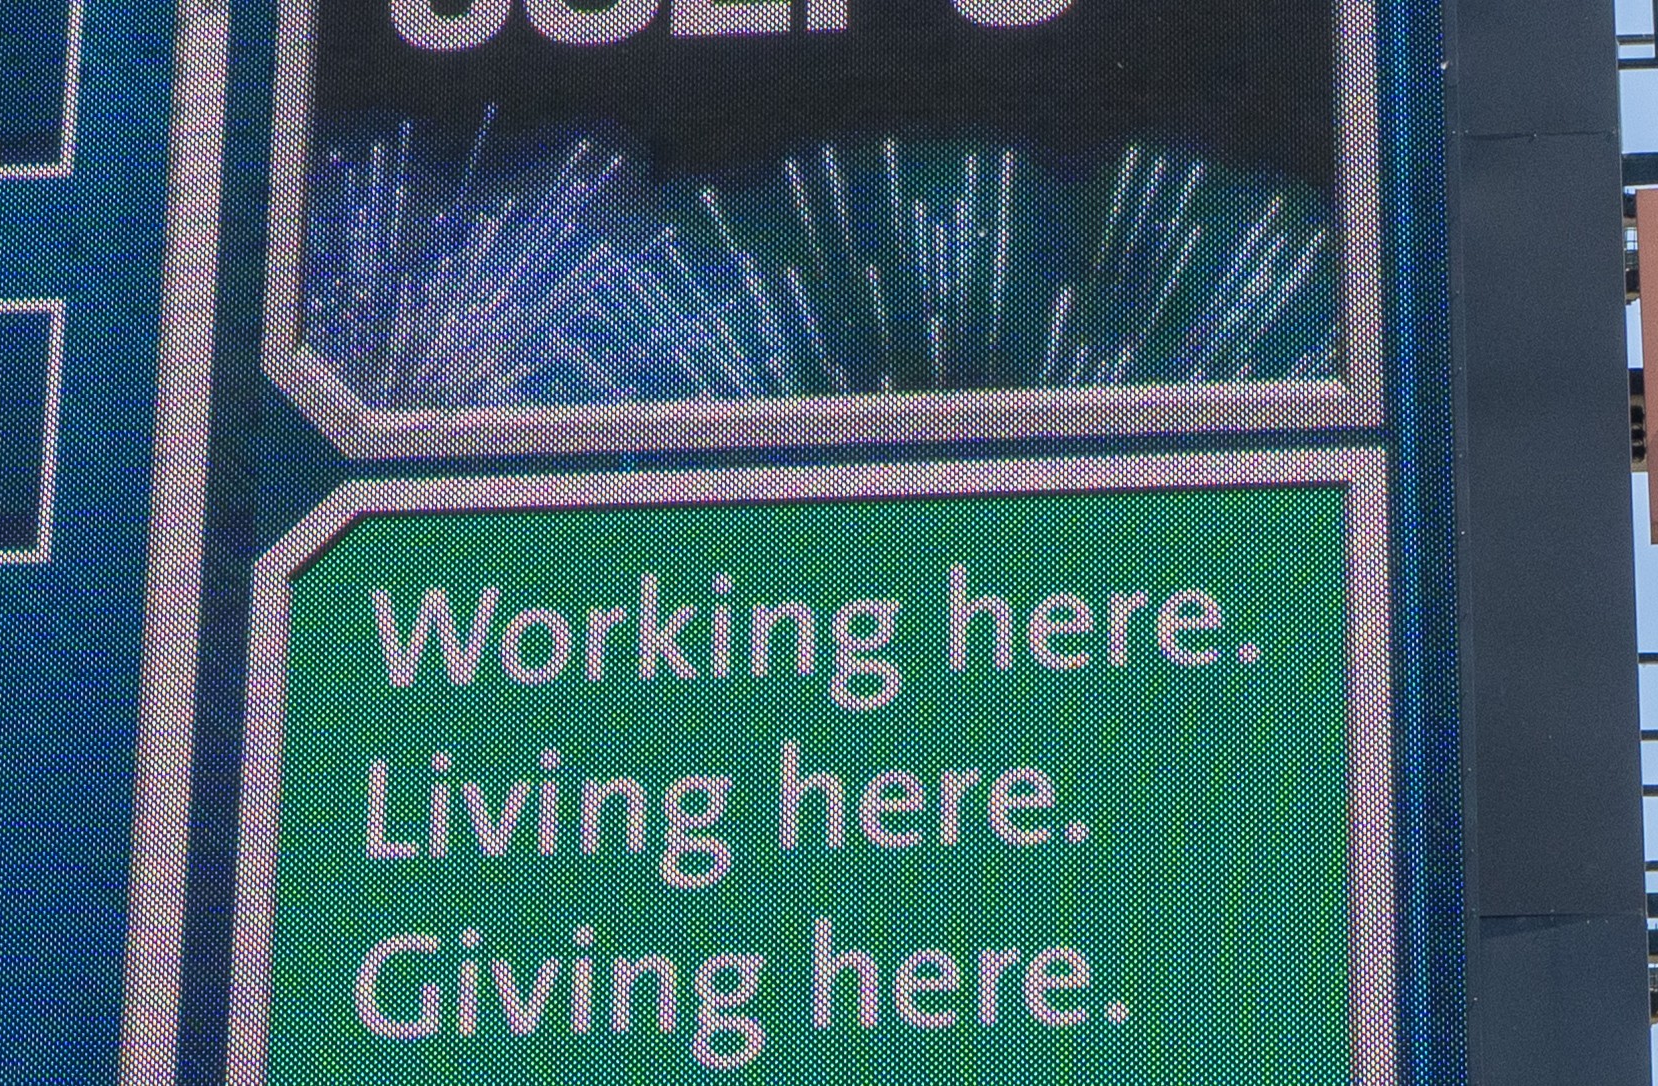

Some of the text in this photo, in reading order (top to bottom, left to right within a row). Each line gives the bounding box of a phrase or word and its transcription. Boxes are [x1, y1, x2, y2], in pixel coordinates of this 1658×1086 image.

[371, 560, 1263, 712] Working here.
[364, 737, 1090, 889] Living here.
[353, 916, 1129, 1071] Giving here.
